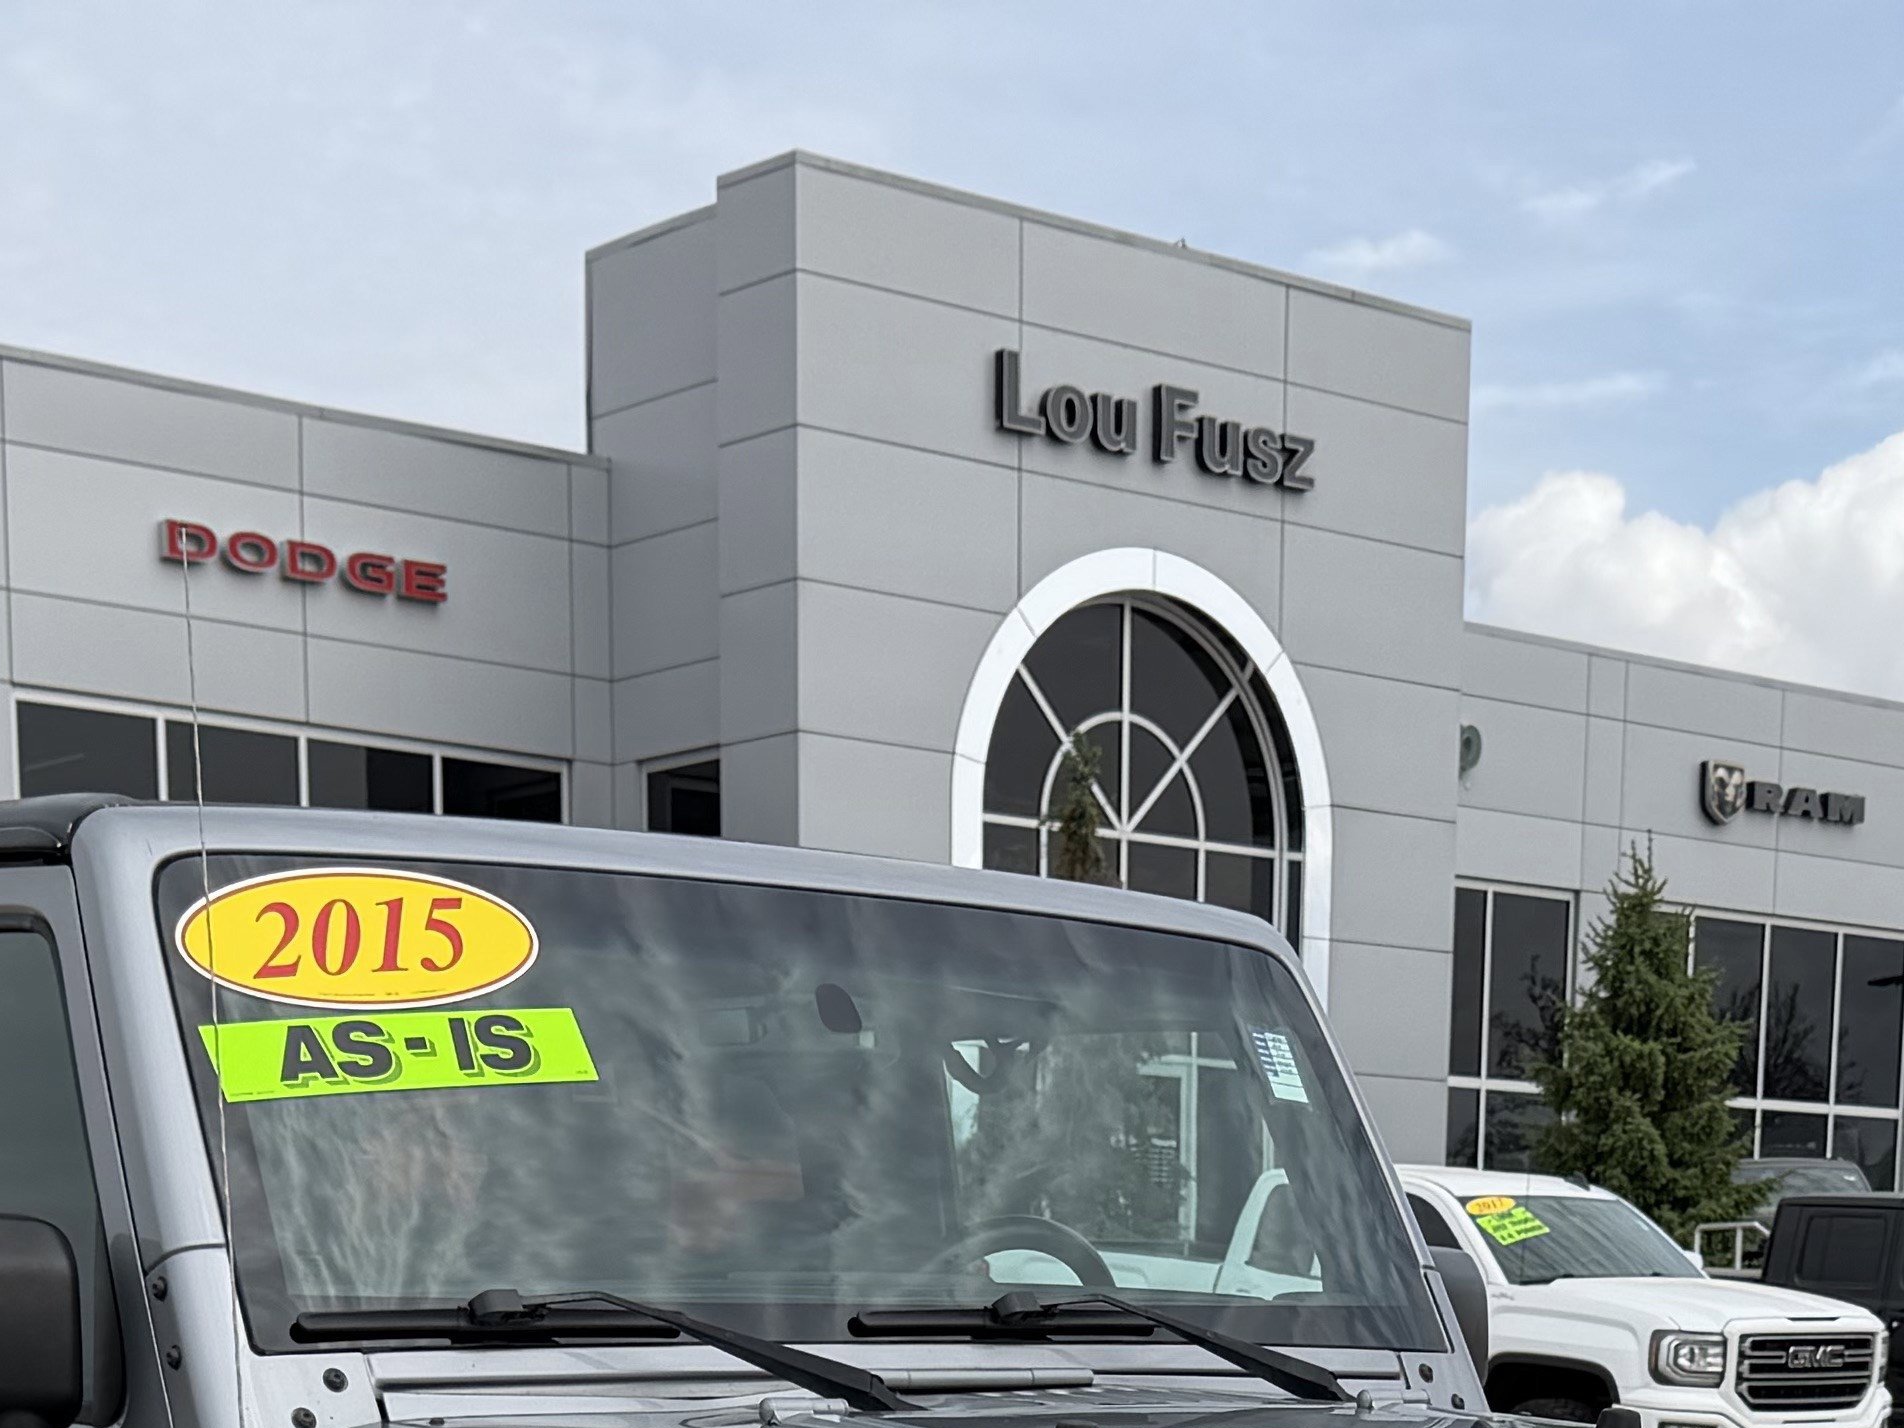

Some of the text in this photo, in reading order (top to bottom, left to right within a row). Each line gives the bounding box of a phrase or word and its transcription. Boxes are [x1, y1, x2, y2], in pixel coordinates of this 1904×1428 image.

[994, 349, 1317, 492] Lou Fusz
[159, 517, 449, 602] DODGE
[1744, 777, 1866, 827] RAM
[253, 896, 465, 980] 2015
[1788, 1345, 1845, 1368] GMC
